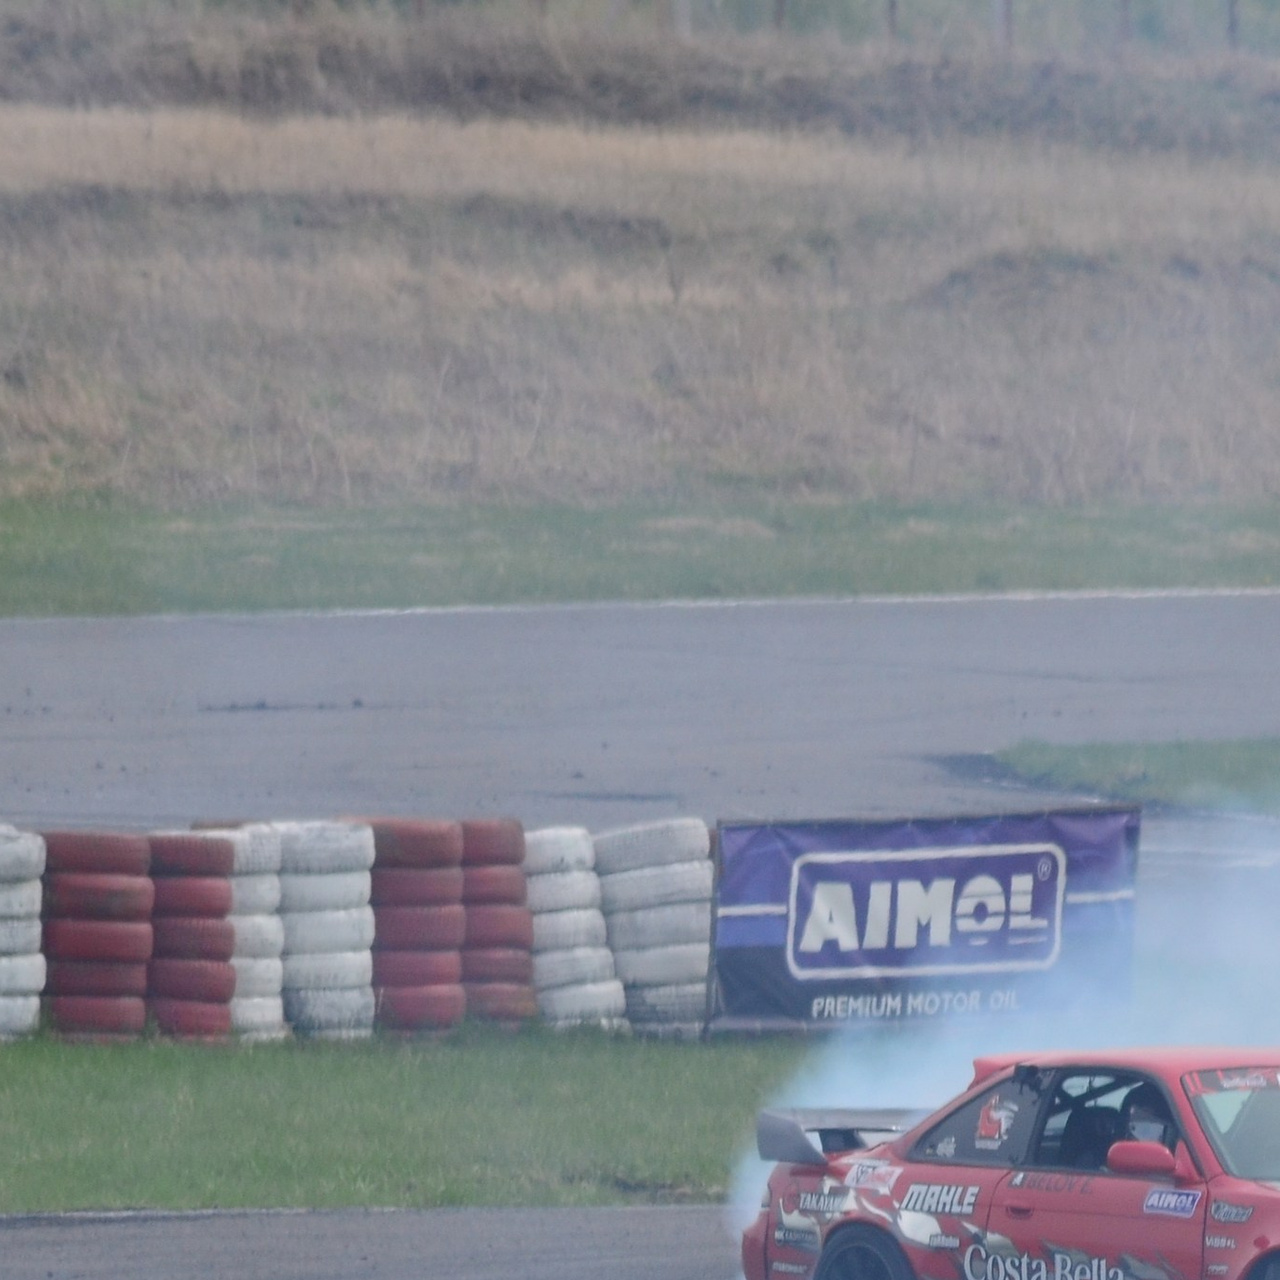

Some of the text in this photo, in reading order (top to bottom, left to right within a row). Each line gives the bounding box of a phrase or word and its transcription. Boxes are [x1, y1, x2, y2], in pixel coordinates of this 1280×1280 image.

[799, 873, 1049, 954] AIMOL
[811, 989, 1021, 1019] PREMIUM MOTOR OIL
[900, 1183, 981, 1214] MAHLE
